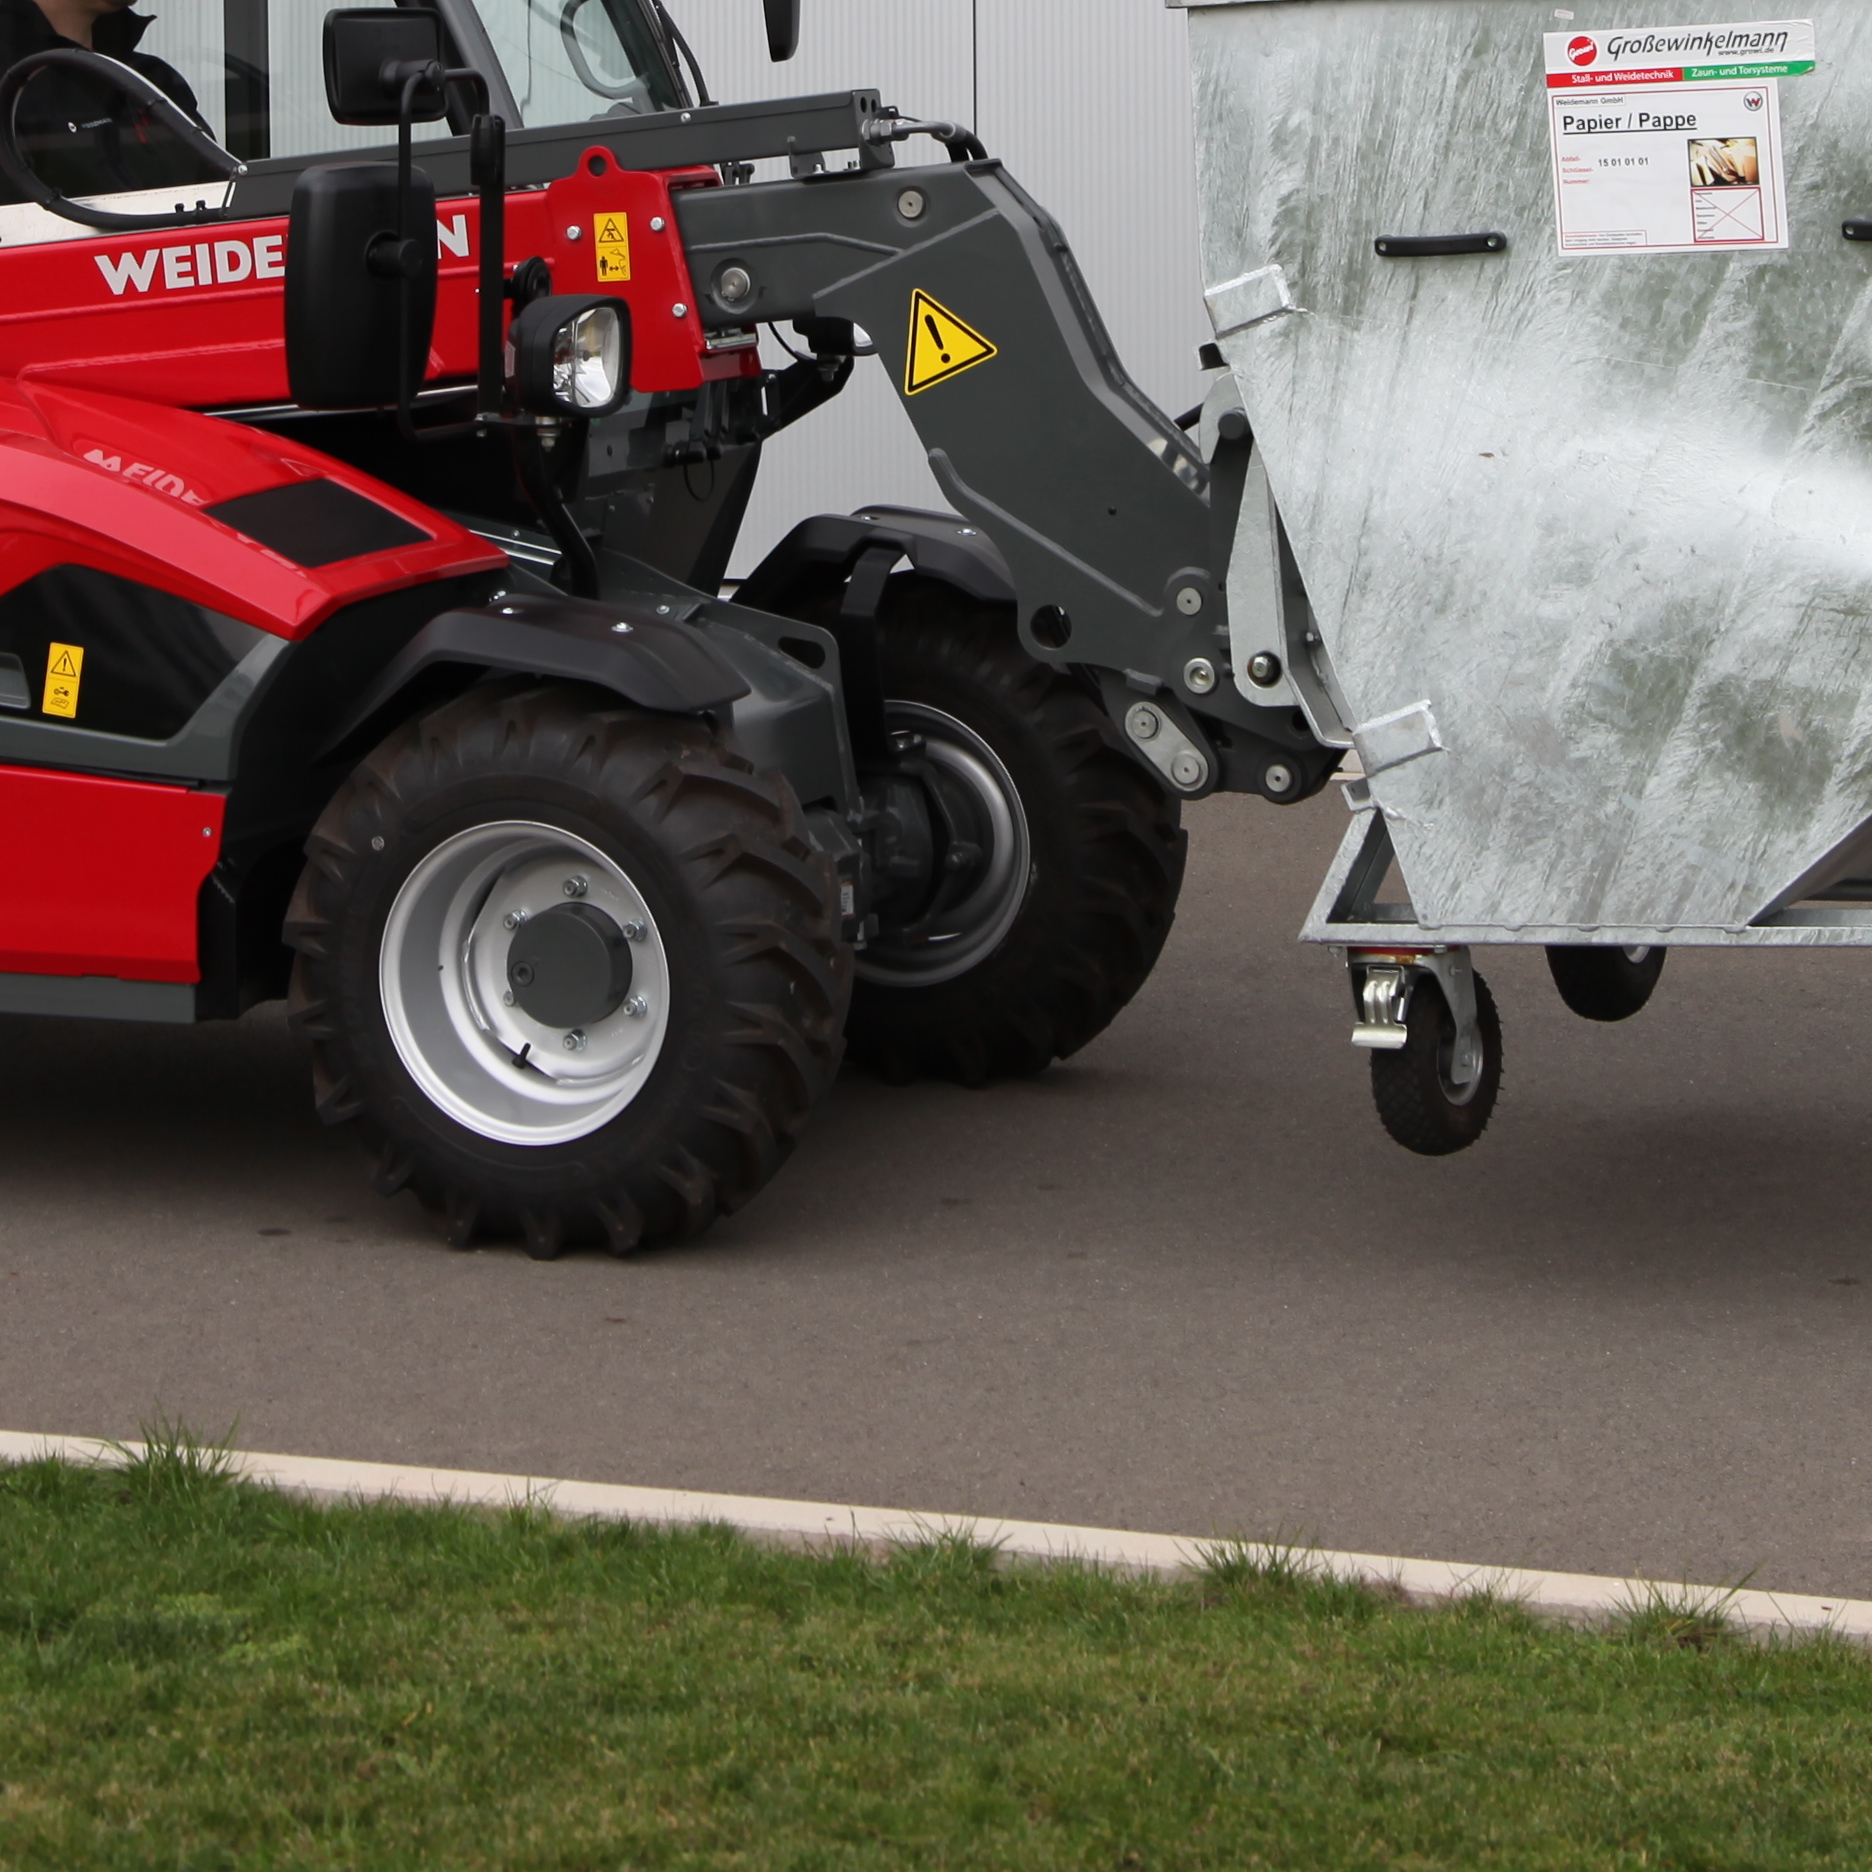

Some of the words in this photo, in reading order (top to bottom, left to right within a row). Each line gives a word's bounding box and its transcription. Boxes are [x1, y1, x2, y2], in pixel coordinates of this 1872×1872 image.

[1607, 30, 1788, 62] Großewinkelmann
[1572, 73, 1593, 83] Stall-
[1595, 73, 1612, 82] und
[1614, 69, 1674, 81] Weidetechnik
[1691, 68, 1717, 77] Zaun-
[1719, 66, 1737, 75] und
[1738, 64, 1788, 76] Torsysteme
[1563, 114, 1622, 132] Papier
[1627, 113, 1632, 128] /
[1639, 112, 1697, 130] Pappe
[1598, 158, 1609, 167] 15
[1611, 157, 1622, 167] 01
[1624, 157, 1635, 166] 01
[1638, 156, 1649, 166] 01
[94, 214, 470, 296] WEIDEN
